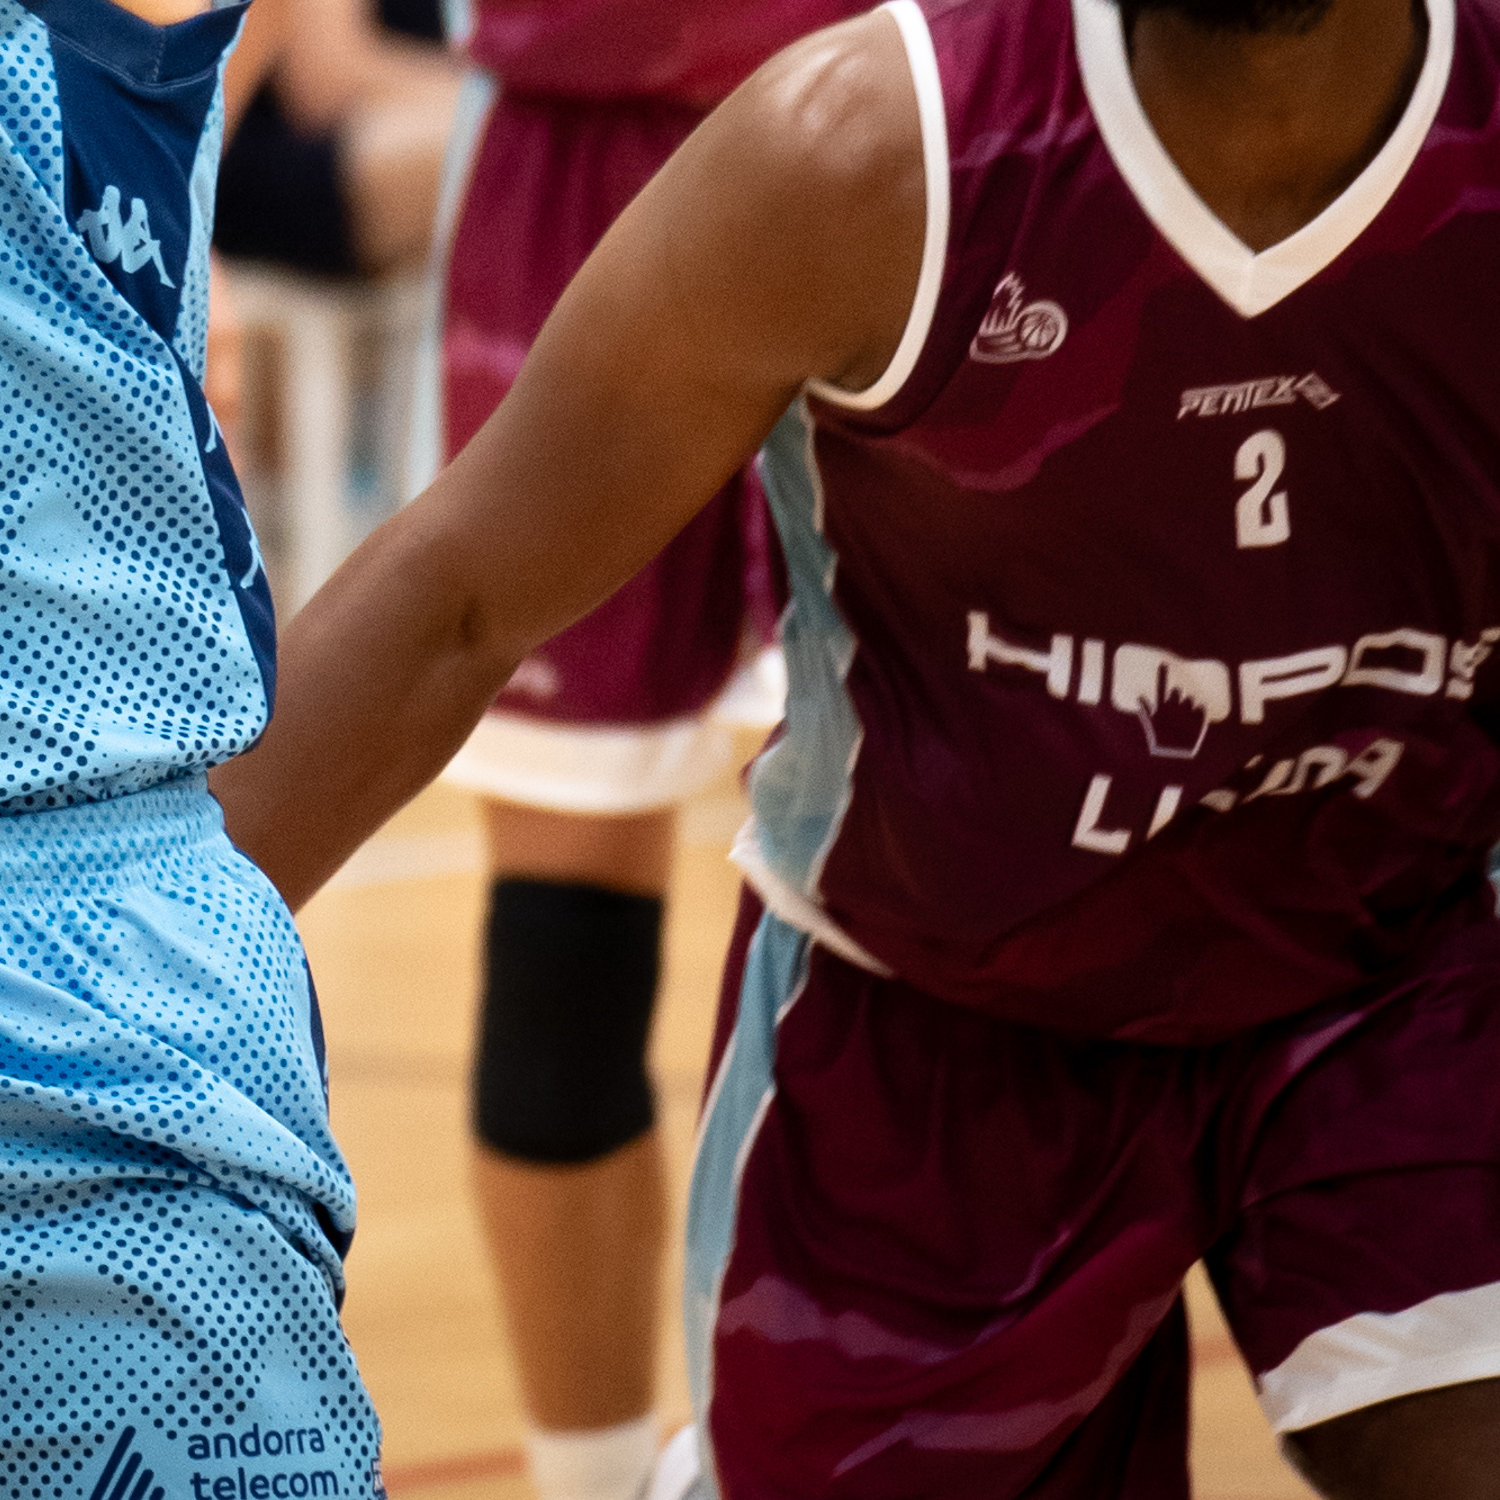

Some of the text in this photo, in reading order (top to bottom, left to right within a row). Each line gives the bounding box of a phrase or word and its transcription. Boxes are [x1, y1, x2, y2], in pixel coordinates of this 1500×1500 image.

[1233, 429, 1290, 548] 2
[187, 1422, 326, 1461] andorra
[190, 1466, 340, 1500] telecom
